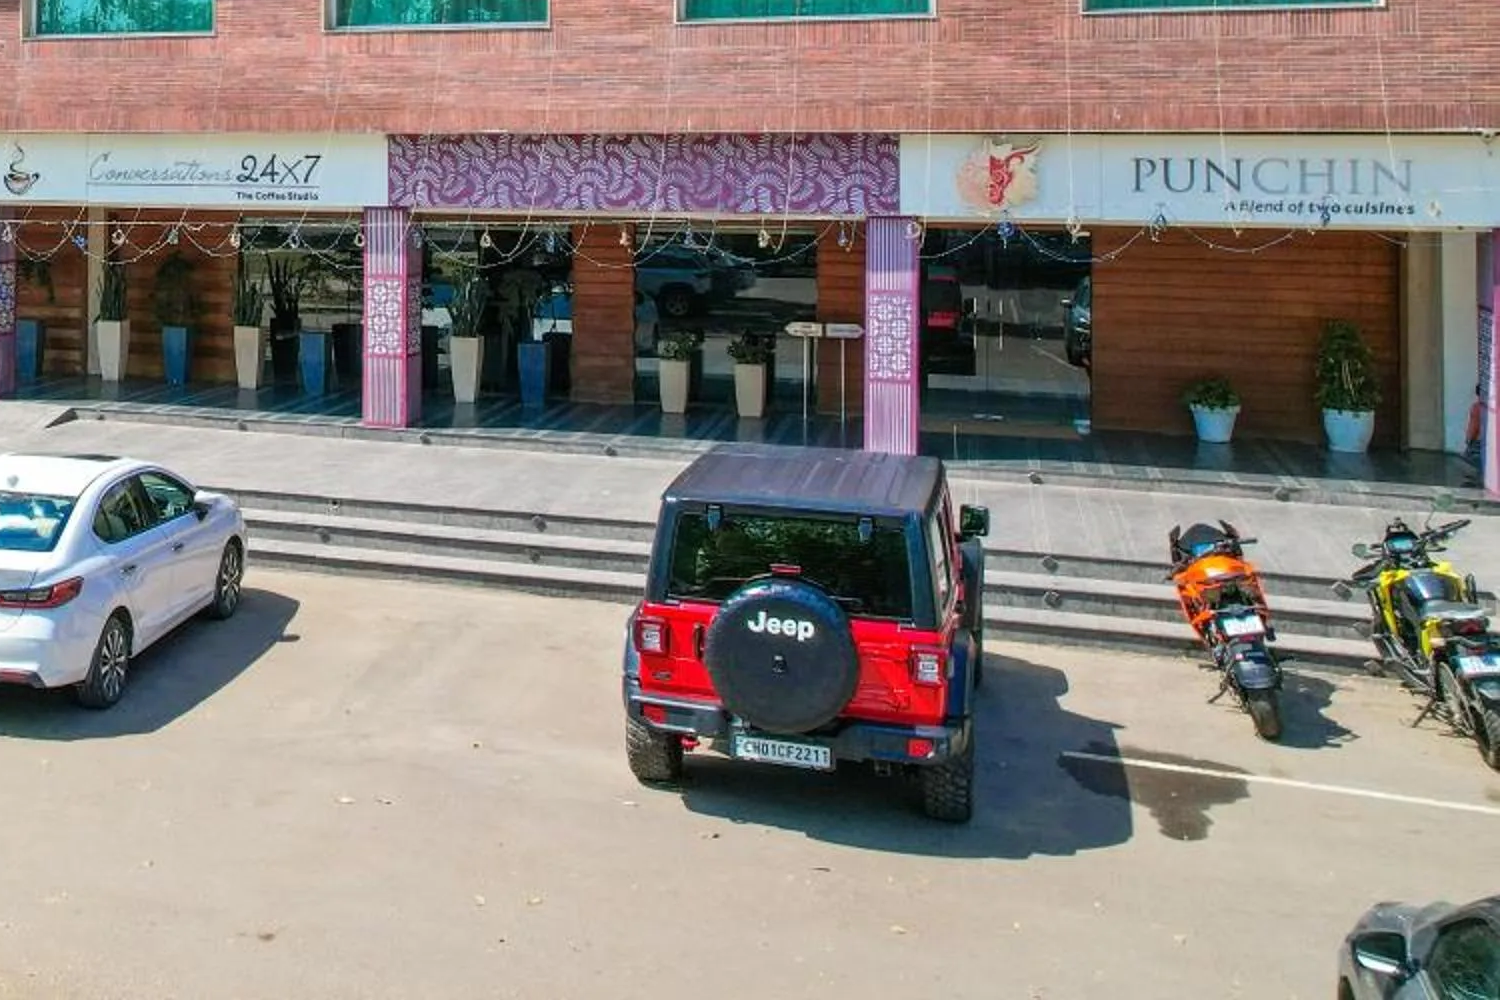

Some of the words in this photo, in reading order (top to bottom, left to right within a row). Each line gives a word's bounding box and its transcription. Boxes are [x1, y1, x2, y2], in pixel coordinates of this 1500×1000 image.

[89, 151, 233, 182] Conversations
[1131, 157, 1414, 196] PUNCHIN
[236, 191, 253, 201] The
[255, 191, 285, 201] Coffee
[286, 191, 319, 201] Studio
[1287, 200, 1304, 215] of
[1344, 201, 1416, 216] cuisines
[747, 611, 815, 642] Jeep
